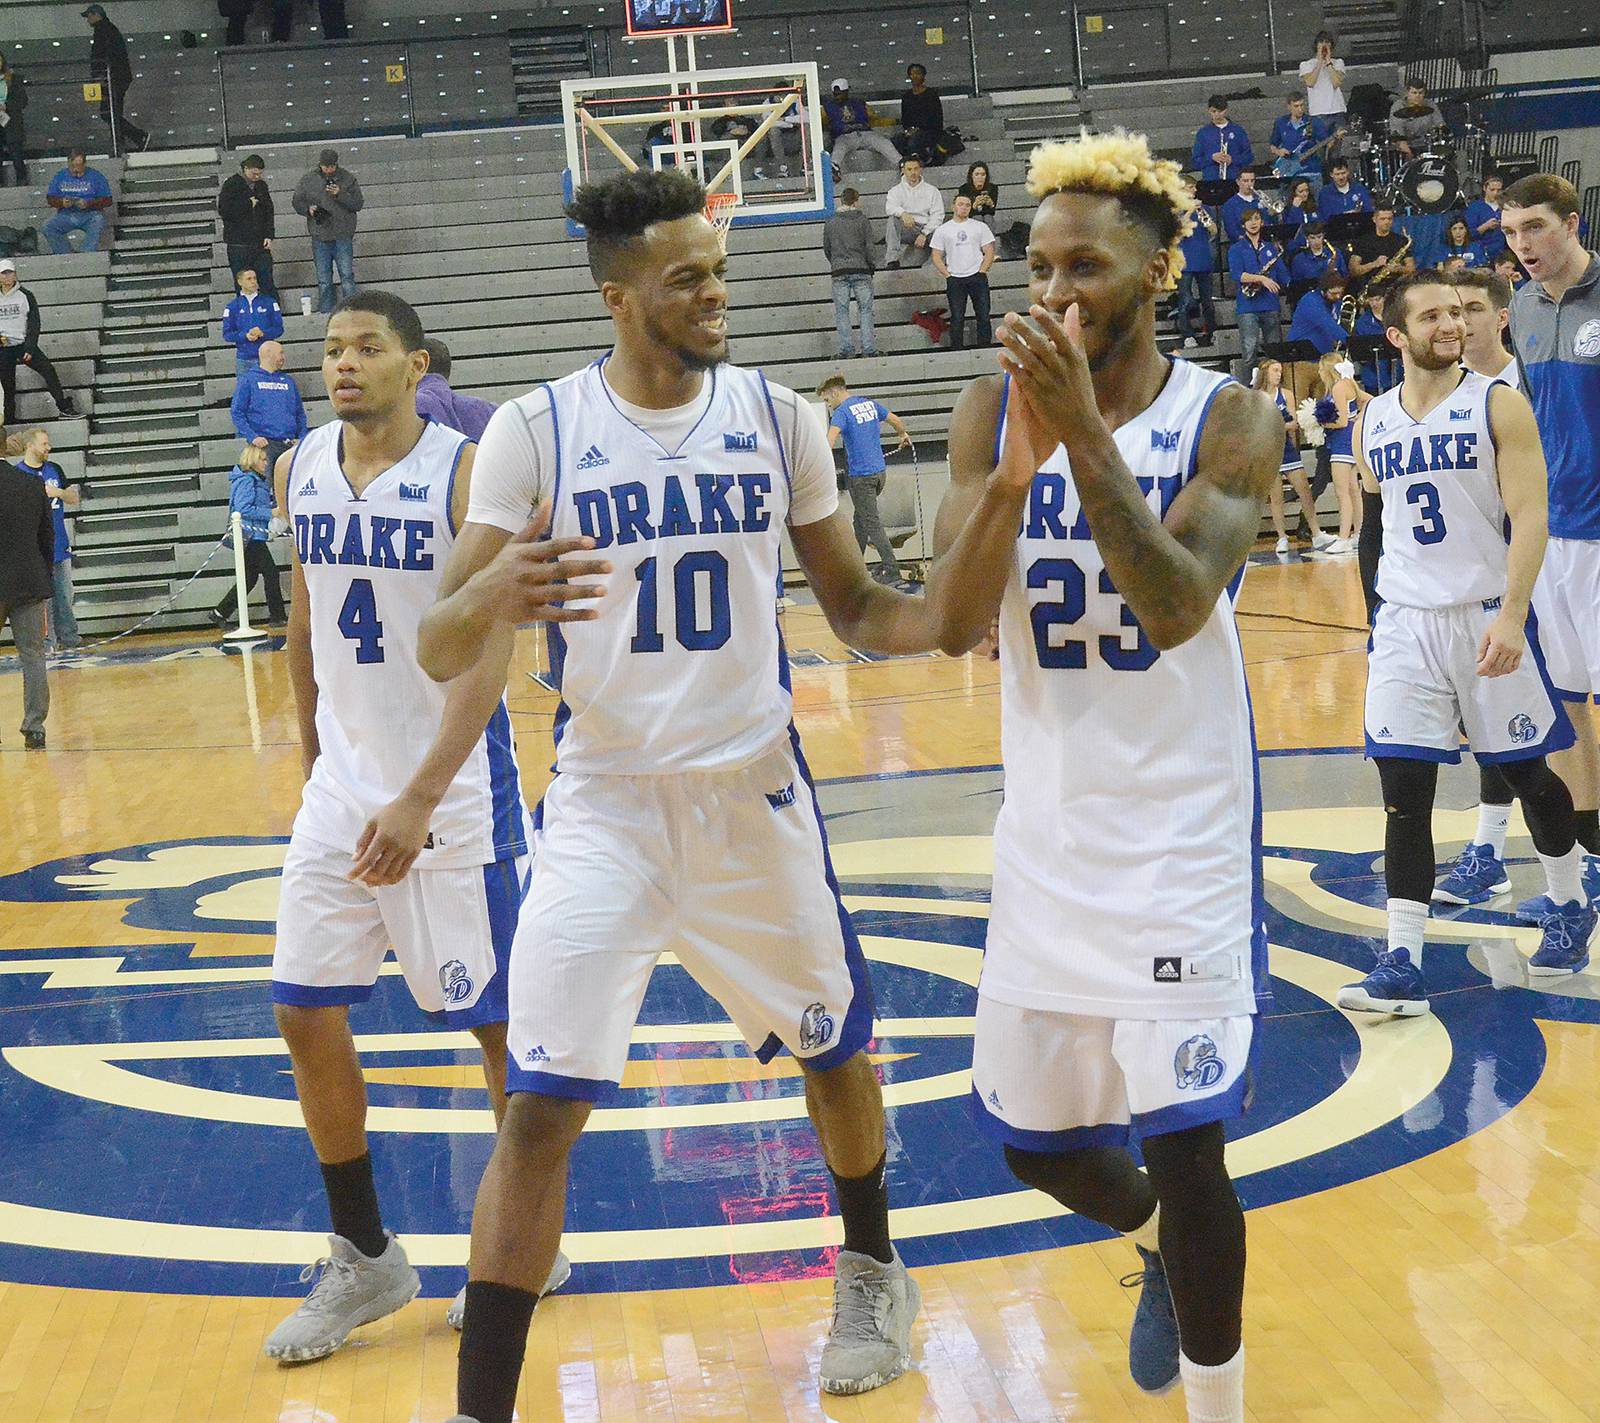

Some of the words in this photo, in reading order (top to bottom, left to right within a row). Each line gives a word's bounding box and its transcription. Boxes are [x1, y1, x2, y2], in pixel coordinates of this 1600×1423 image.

[389, 68, 400, 79] K
[576, 458, 610, 471] adidas
[1369, 433, 1478, 483] DRAKE
[298, 489, 318, 497] adidas
[572, 472, 772, 549] DRAKE
[1406, 481, 1448, 545] 3
[294, 513, 434, 571] DRAKE
[337, 578, 385, 664] 4
[630, 550, 732, 654] 10
[1027, 558, 1161, 671] 23
[1190, 963, 1198, 975] L
